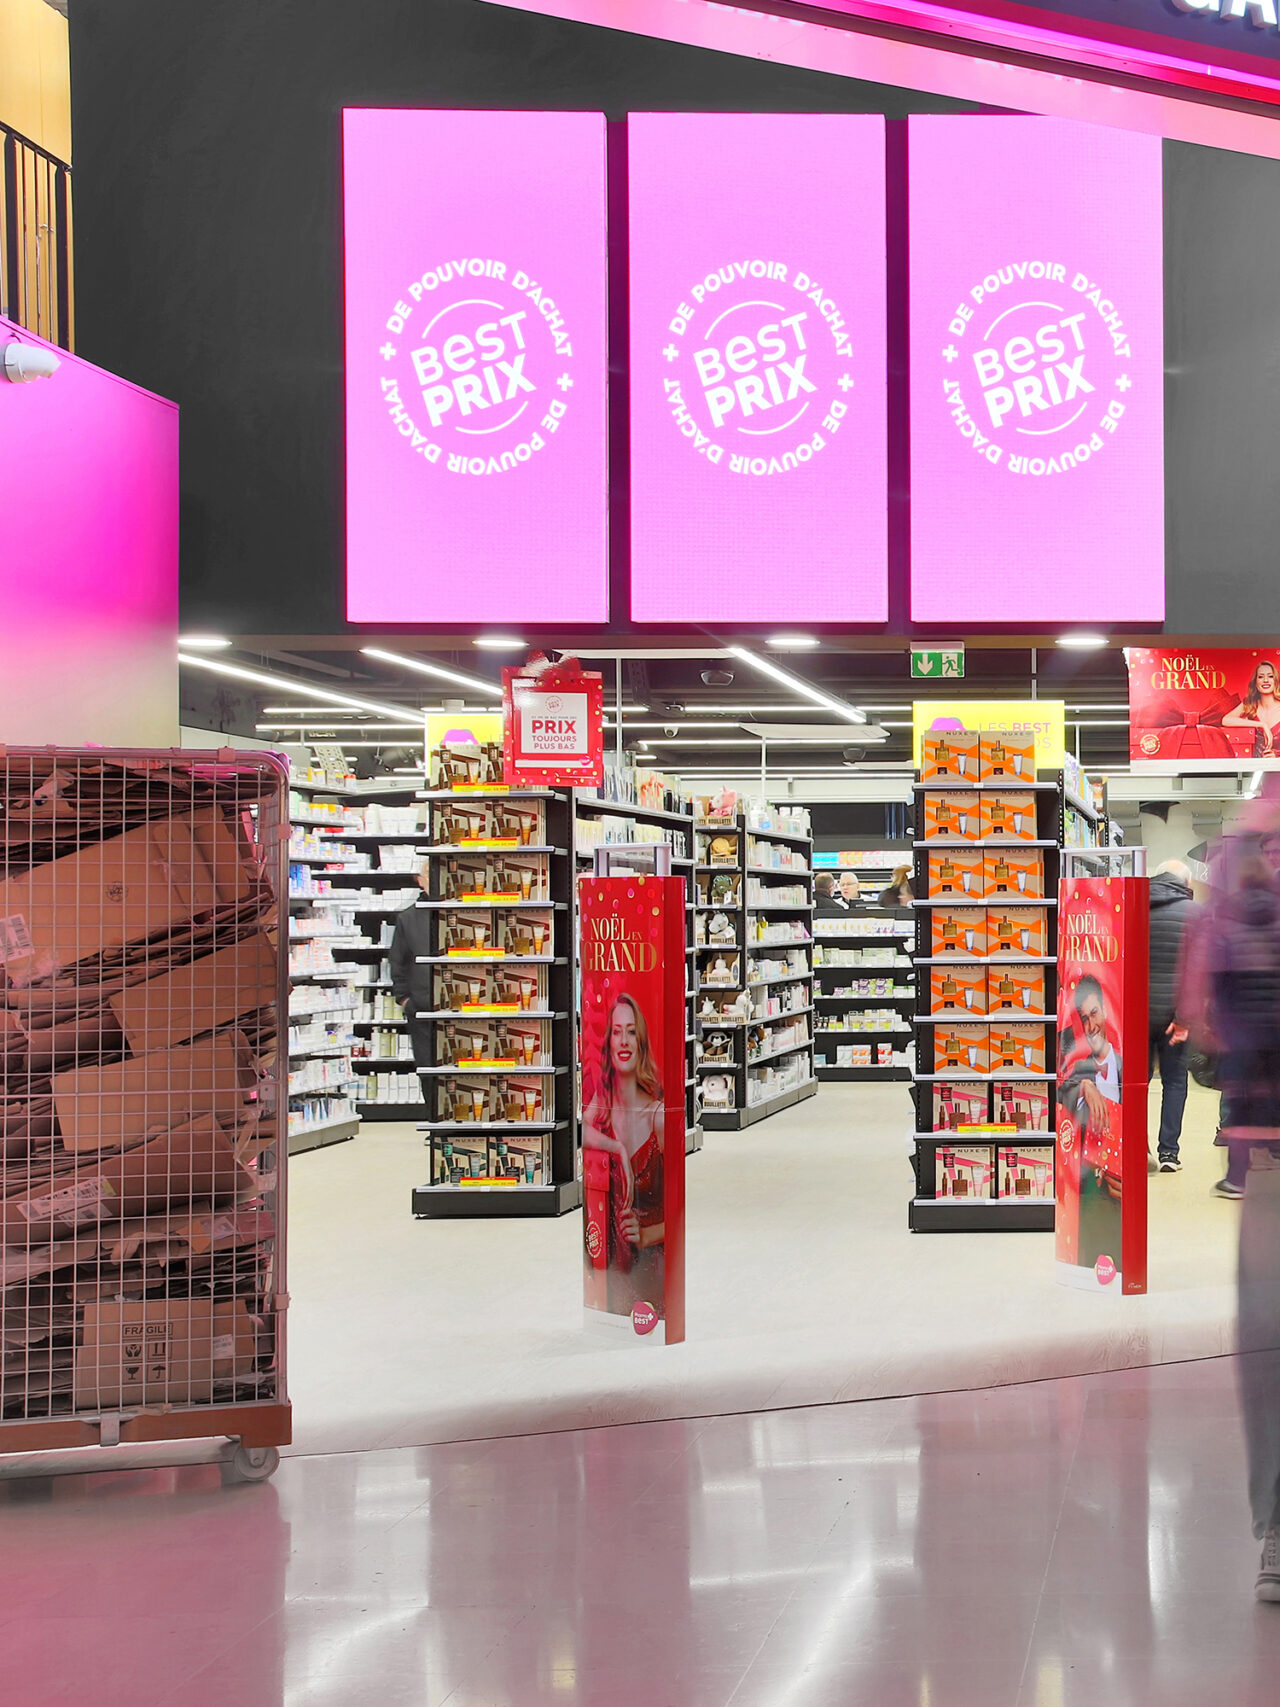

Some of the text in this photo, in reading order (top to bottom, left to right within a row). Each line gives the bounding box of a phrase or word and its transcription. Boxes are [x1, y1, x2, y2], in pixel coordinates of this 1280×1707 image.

[386, 300, 413, 334] DE
[408, 258, 506, 302] POUVOIR
[511, 270, 572, 357] D'ACHAT
[669, 302, 695, 336] DE
[691, 260, 787, 303] POUVOIR
[793, 272, 852, 357] D'ACHAT
[948, 302, 974, 336] DE
[970, 261, 1066, 304] POUVOIR
[1071, 272, 1131, 358] D'ACHAT
[422, 353, 537, 427] PRIX
[704, 354, 818, 428] PRIX
[984, 355, 1096, 428] PRIX
[381, 377, 442, 463] D'ACHAT
[540, 399, 567, 433] DE
[663, 378, 724, 464] D'ACHAT
[822, 400, 848, 433] DE
[943, 379, 1003, 464] D'ACHAT
[1100, 400, 1126, 433] DE
[447, 432, 546, 475] POUVOIR
[729, 432, 826, 476] POUVOIR
[1008, 432, 1104, 476] POUVOIR
[1151, 672, 1226, 690] GRAND
[1162, 654, 1205, 671] NOËL
[532, 720, 576, 734] PRIX
[1012, 722, 1051, 734] BEST
[591, 913, 630, 940] NOËL
[1067, 910, 1100, 934] NOËL
[583, 941, 657, 972] GRAND
[1060, 936, 1118, 962] GRAND
[124, 1324, 171, 1336] FRAGILE
